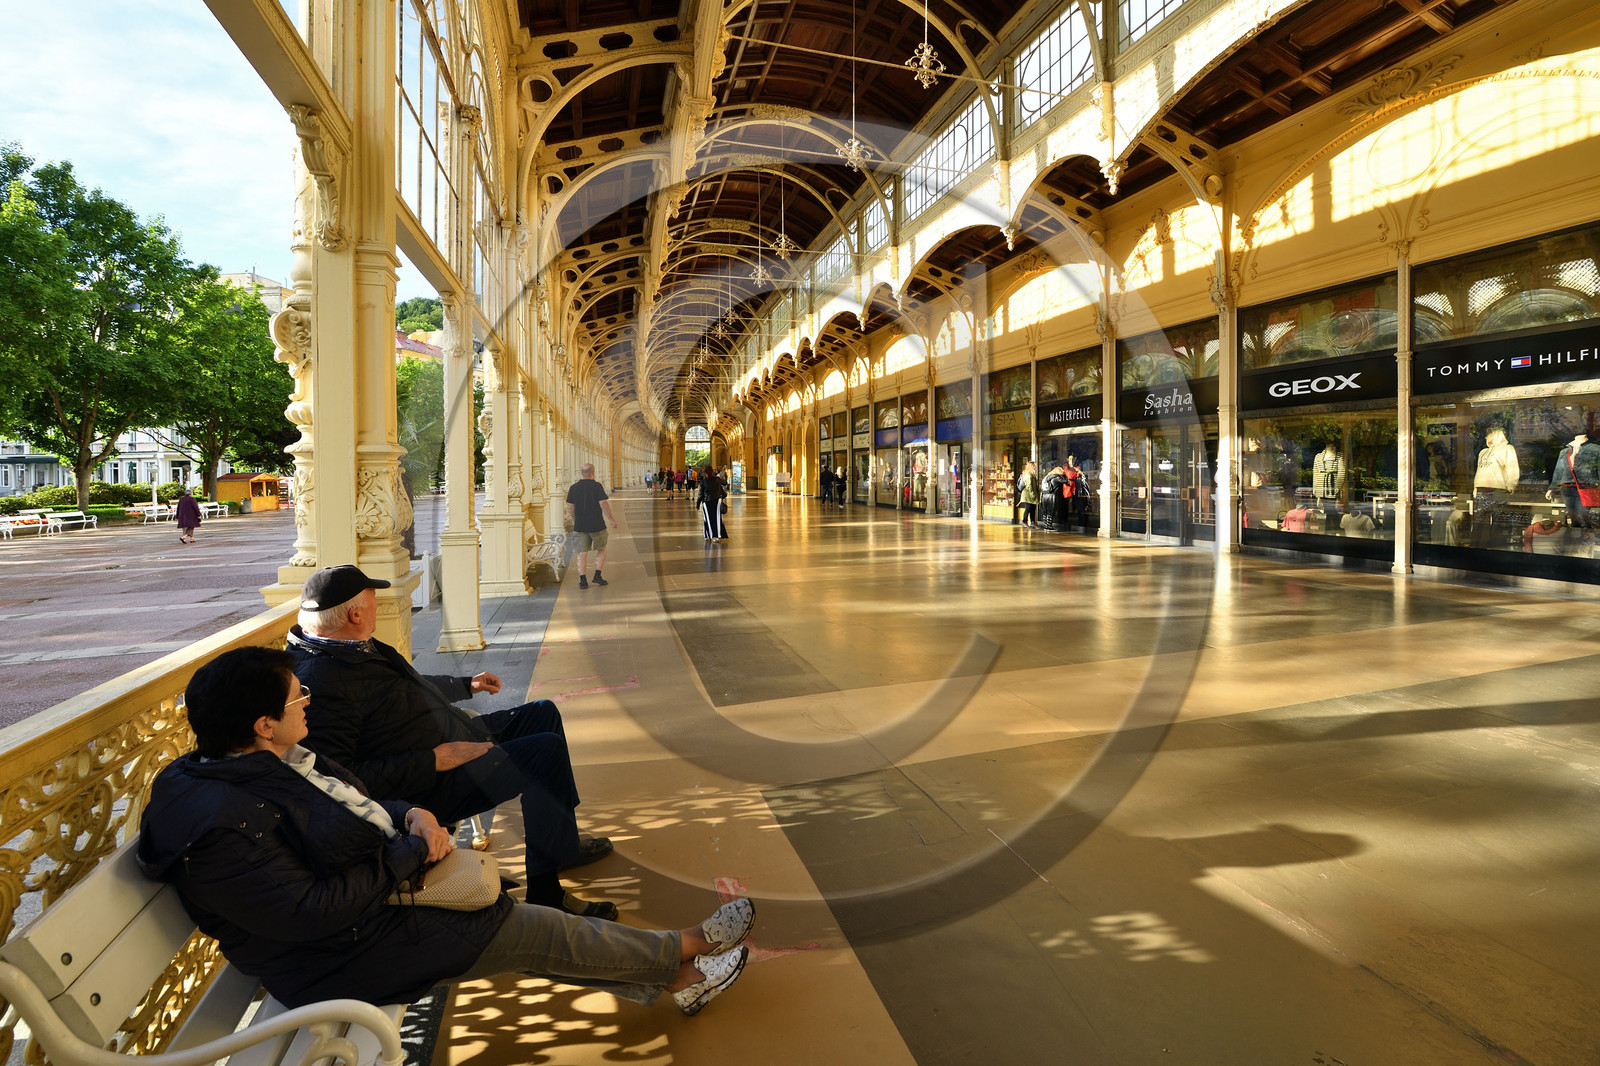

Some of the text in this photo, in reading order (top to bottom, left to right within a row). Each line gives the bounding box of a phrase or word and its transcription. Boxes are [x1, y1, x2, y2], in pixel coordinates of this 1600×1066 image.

[1427, 358, 1504, 378] TOMMY
[1268, 372, 1361, 398] GEOX
[1144, 388, 1193, 410] Sasha
[997, 412, 1017, 426] SPA
[1049, 406, 1090, 423] MASTERPELLE
[1143, 407, 1193, 416] fashion
